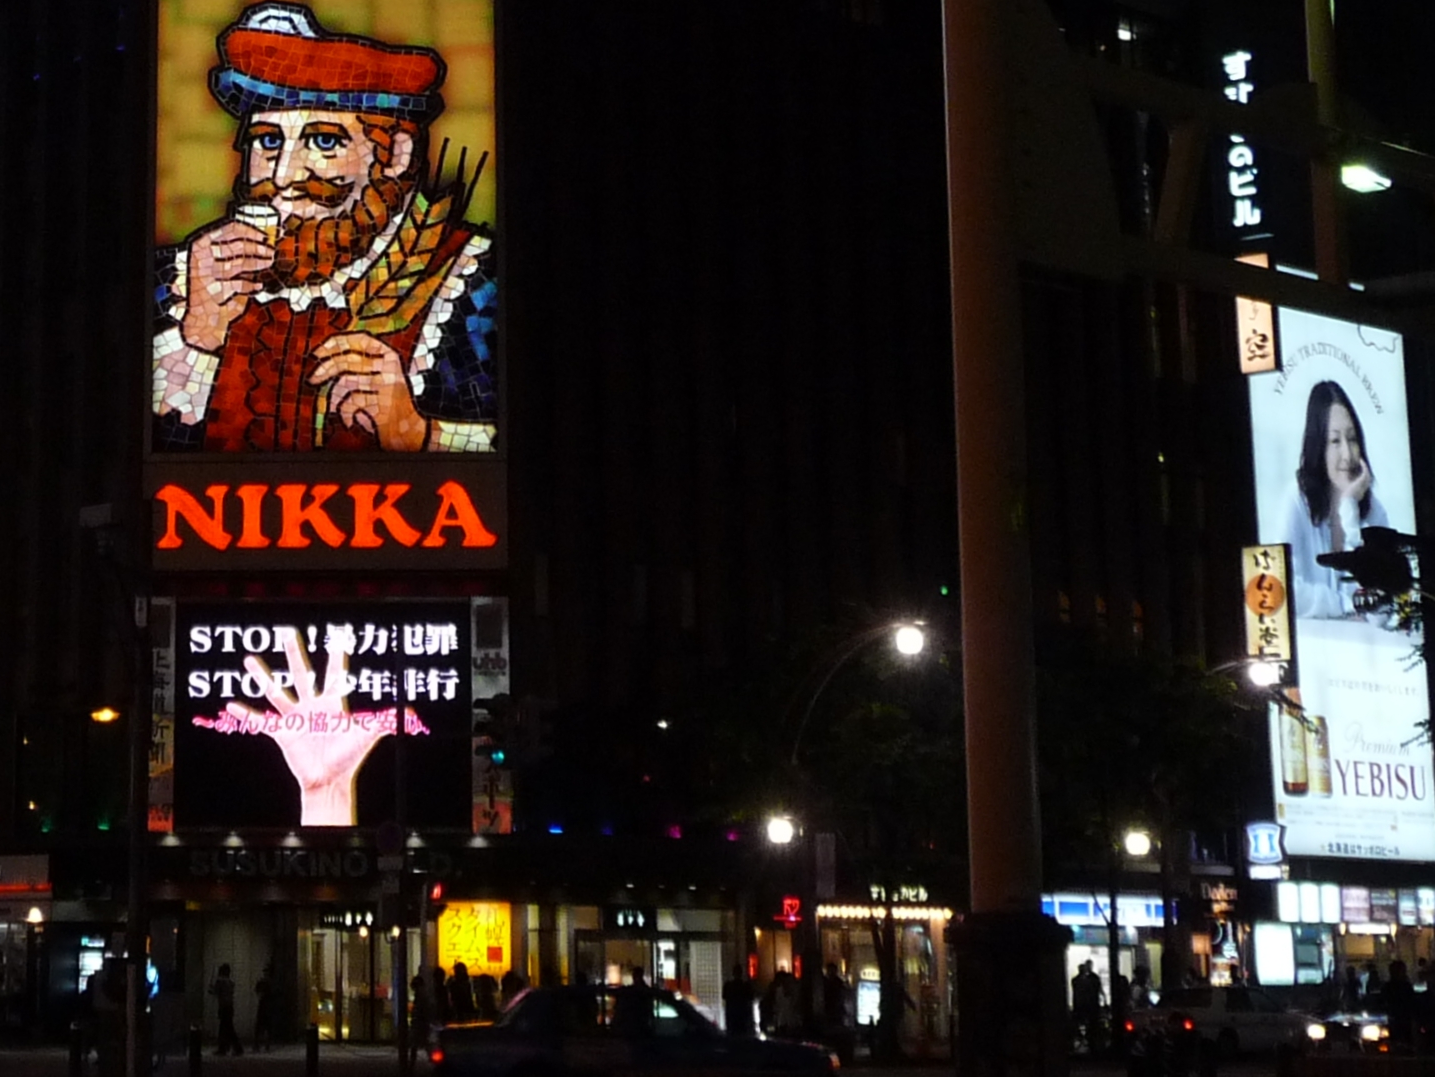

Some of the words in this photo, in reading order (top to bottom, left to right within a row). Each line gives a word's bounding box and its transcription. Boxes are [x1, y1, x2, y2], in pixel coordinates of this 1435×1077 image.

[1221, 50, 1262, 227] すすのビル
[1297, 341, 1362, 379] TRADITIONAL
[154, 479, 499, 552] NIKKA
[1343, 719, 1411, 758] Premium
[1334, 758, 1427, 801] YEBISU
